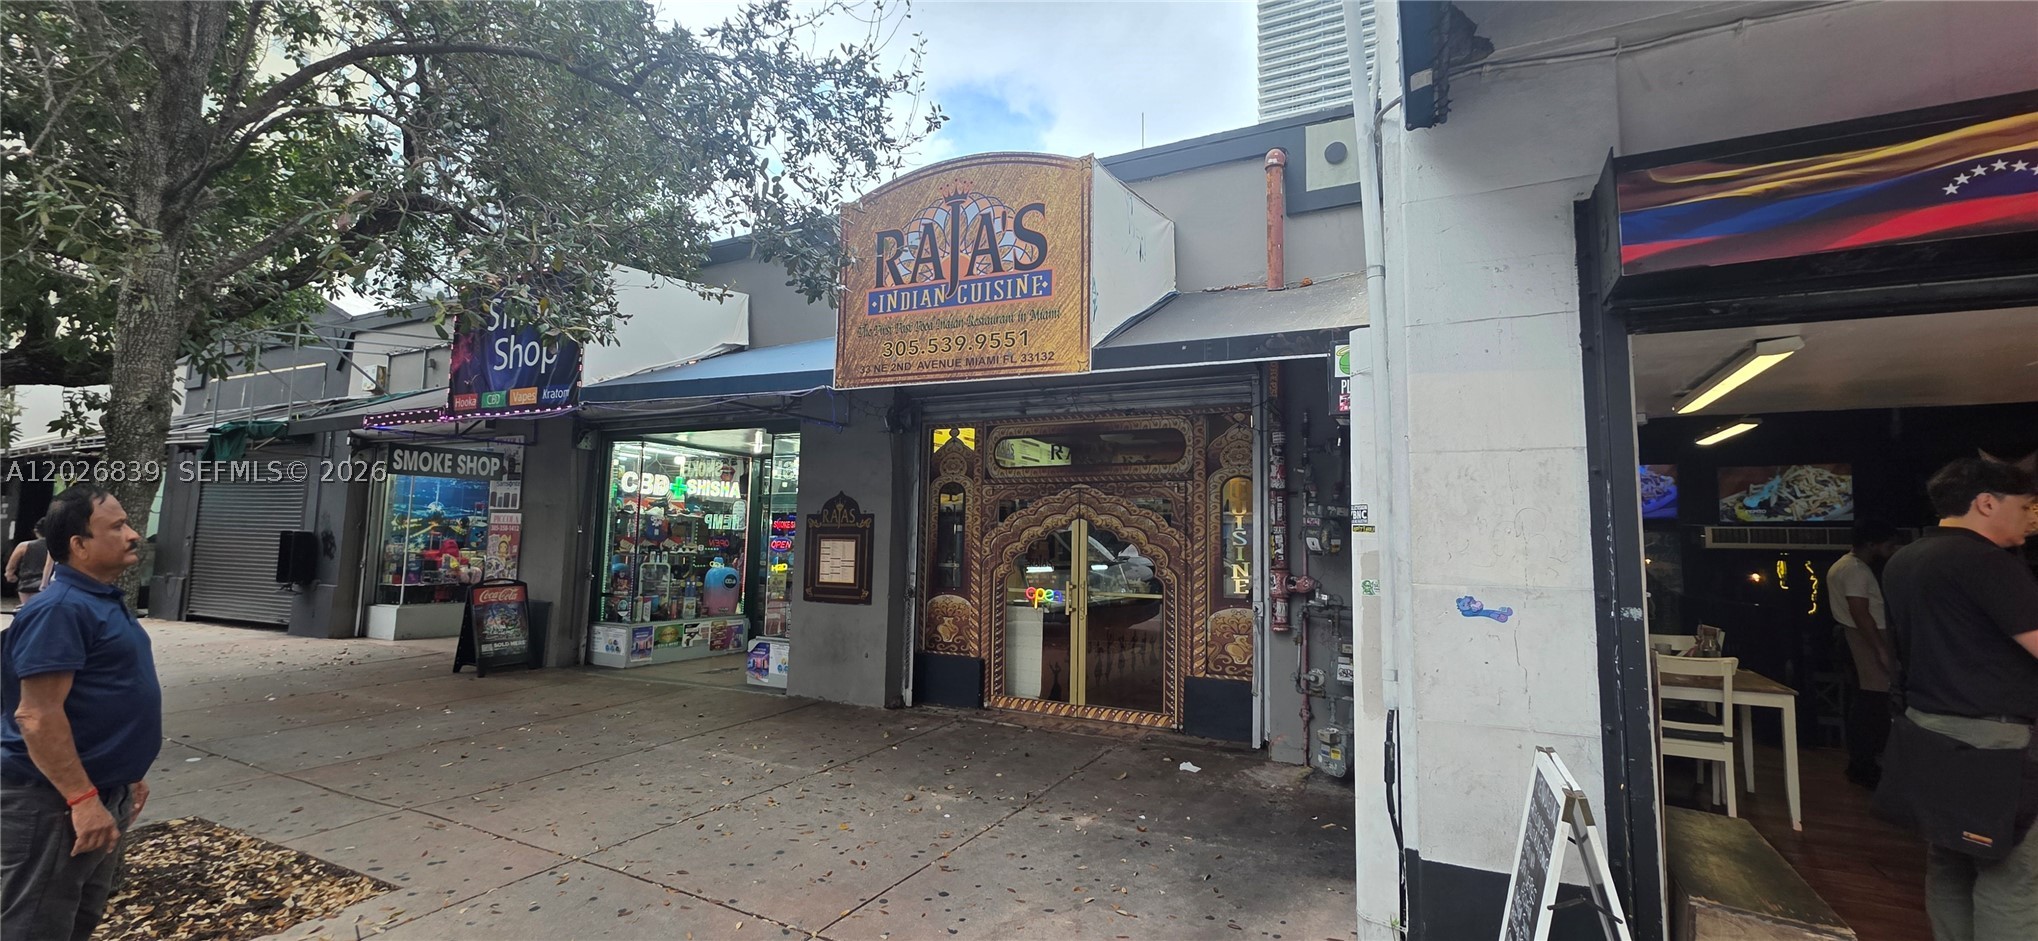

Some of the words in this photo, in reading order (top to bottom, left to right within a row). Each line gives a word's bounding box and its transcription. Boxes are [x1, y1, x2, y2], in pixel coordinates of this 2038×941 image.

[878, 284, 947, 313] INDIAN
[957, 273, 1043, 304] CUISINE
[966, 313, 1015, 328] Restaurant
[1017, 311, 1027, 322] in
[1029, 307, 1062, 320] Miami
[493, 335, 559, 374] Shop
[882, 329, 1030, 358] 305.539.9551
[859, 365, 871, 375] 33
[873, 363, 888, 374] NE
[890, 362, 912, 372] 2ND
[917, 357, 962, 370] AVENUE
[965, 354, 999, 367] MIAMI
[1002, 352, 1017, 364] FL
[1020, 351, 1055, 363] 33132
[455, 397, 476, 408] Hooka
[486, 394, 500, 405] CBD
[513, 391, 536, 403] Vapes
[393, 449, 453, 474] SMOKE
[457, 454, 500, 477] SHOP
[621, 471, 670, 496] CBD
[686, 479, 741, 498] SHISHA
[771, 539, 792, 549] OPEN
